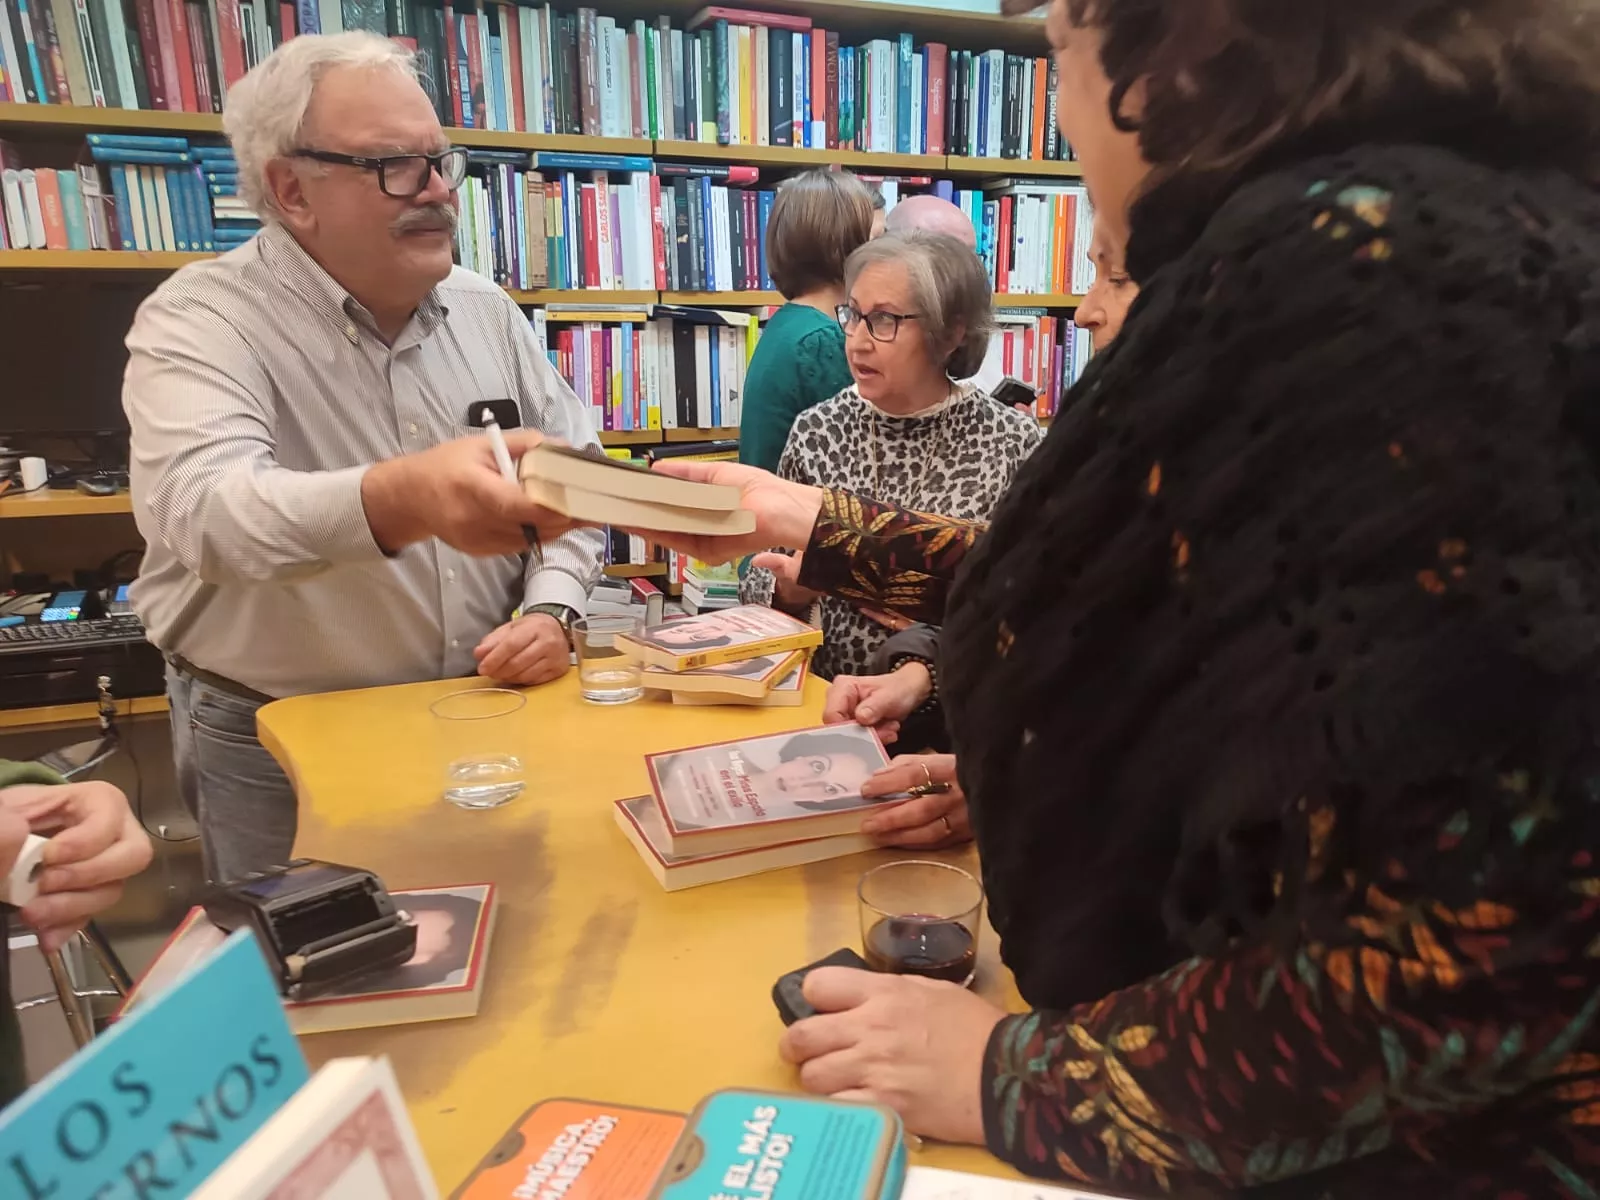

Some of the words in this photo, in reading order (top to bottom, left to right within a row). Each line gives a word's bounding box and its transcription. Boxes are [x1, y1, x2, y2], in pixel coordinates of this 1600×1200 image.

[599, 209, 609, 243] CARLOS
[8, 1059, 154, 1200] LOS
[737, 1105, 779, 1155] MÁS
[722, 1158, 756, 1189] EL
